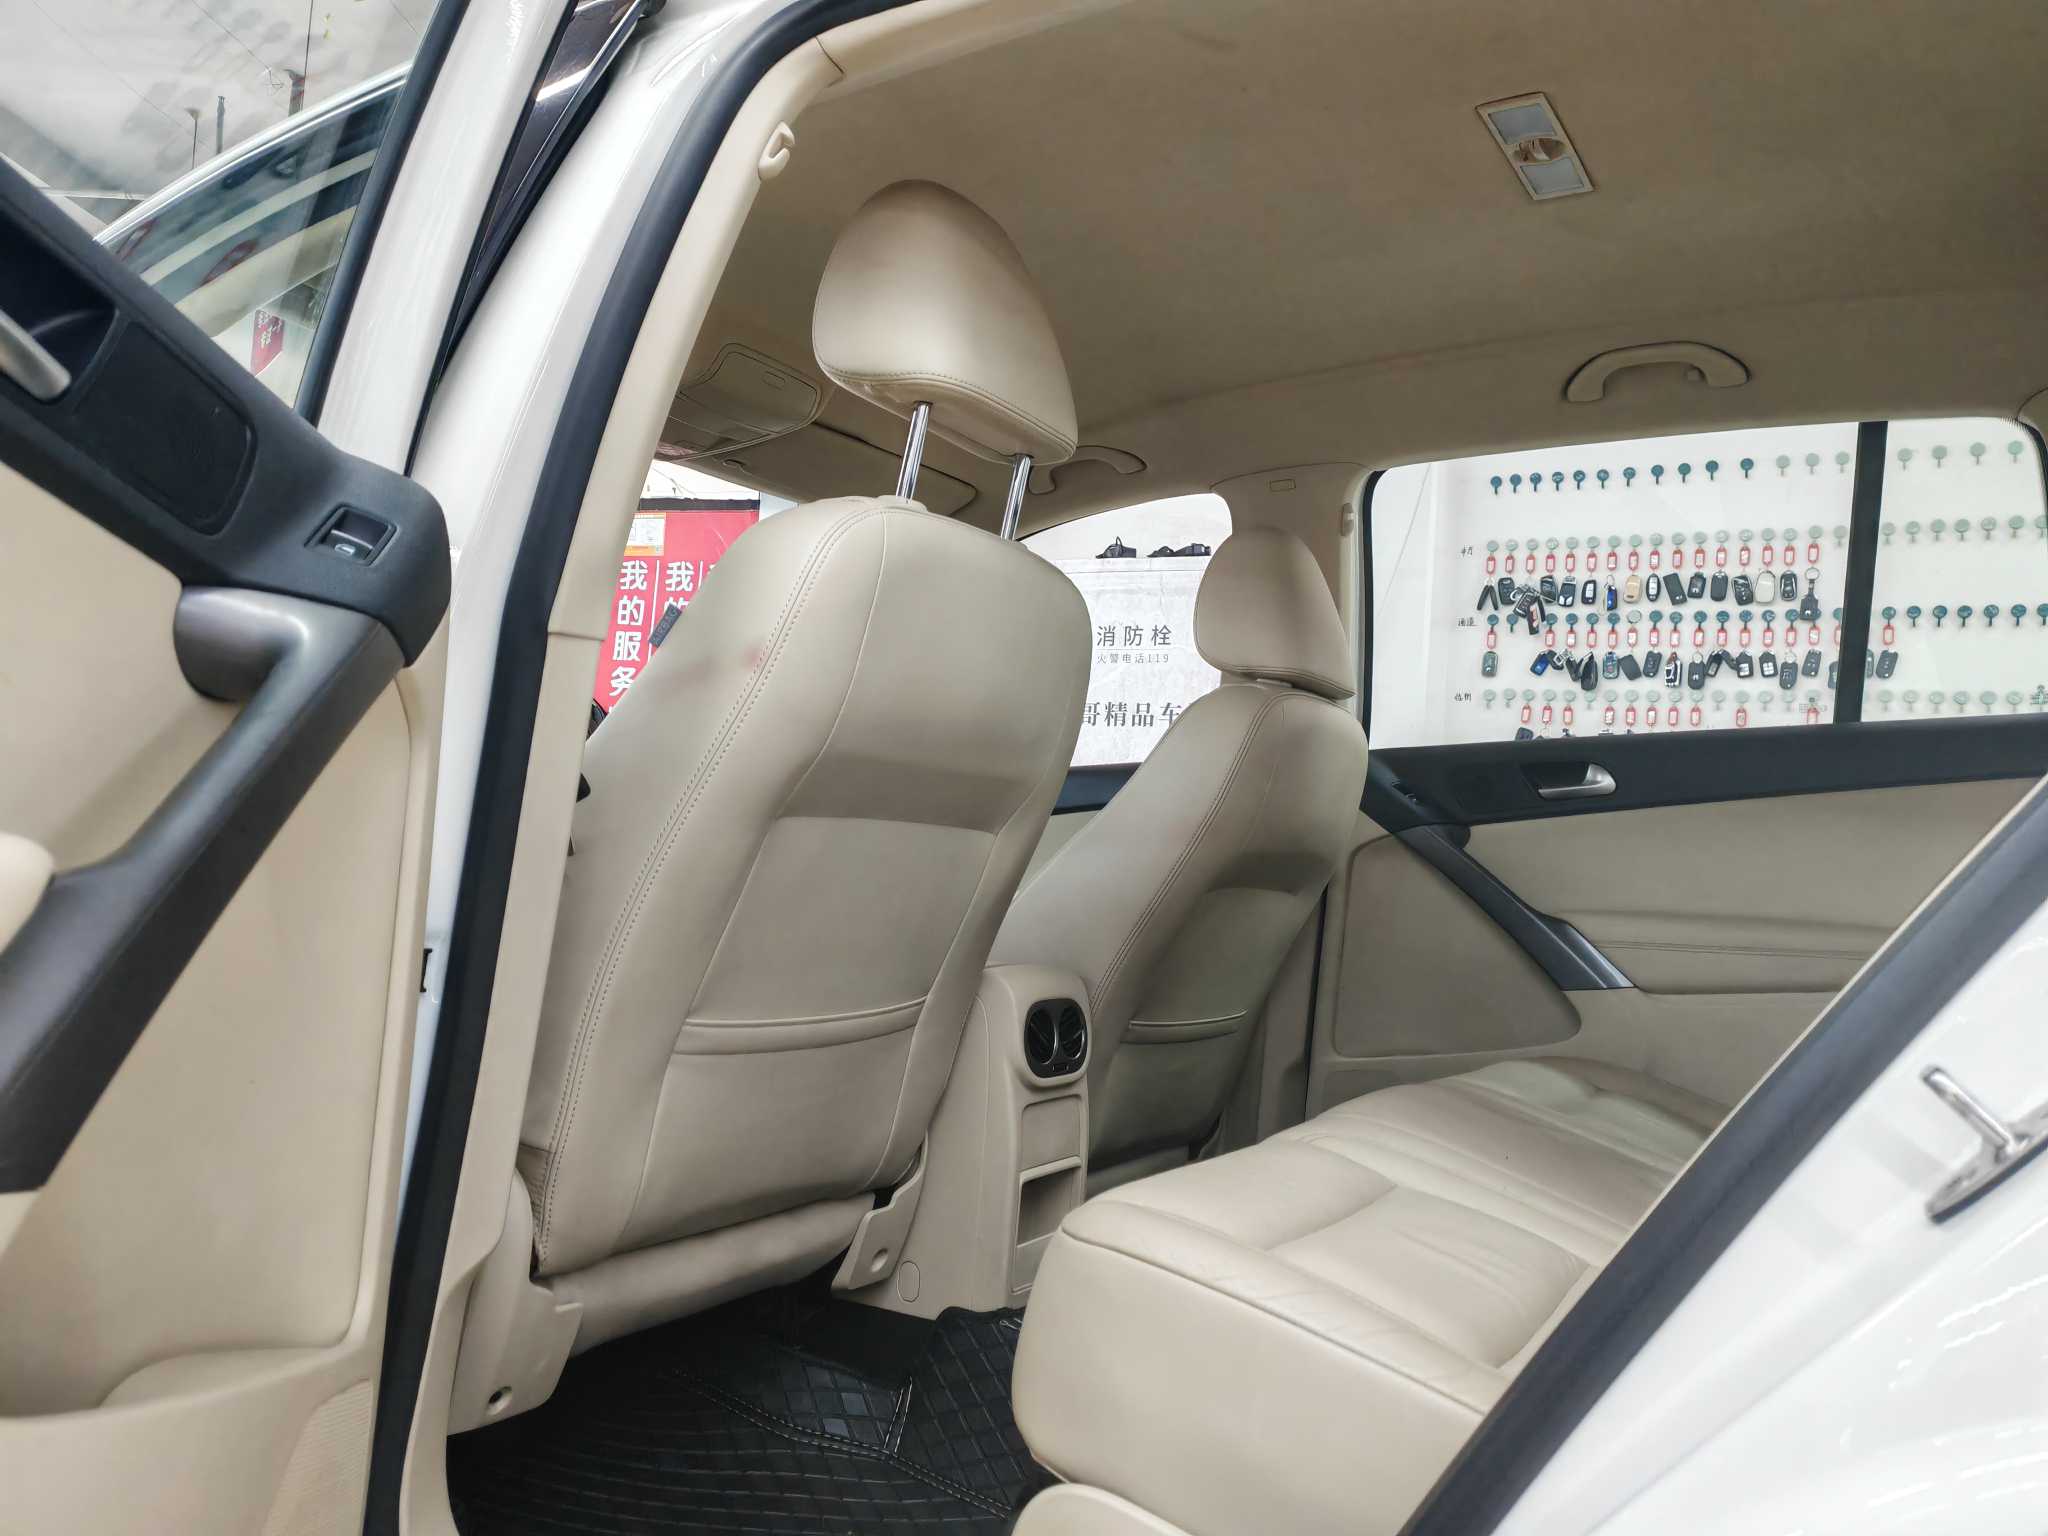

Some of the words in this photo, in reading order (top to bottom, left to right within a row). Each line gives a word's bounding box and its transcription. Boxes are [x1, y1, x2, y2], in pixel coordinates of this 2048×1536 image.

[608, 560, 648, 713] 我的服务
[1096, 624, 1172, 647] 消防栓
[1096, 653, 1169, 665] 火警电话119
